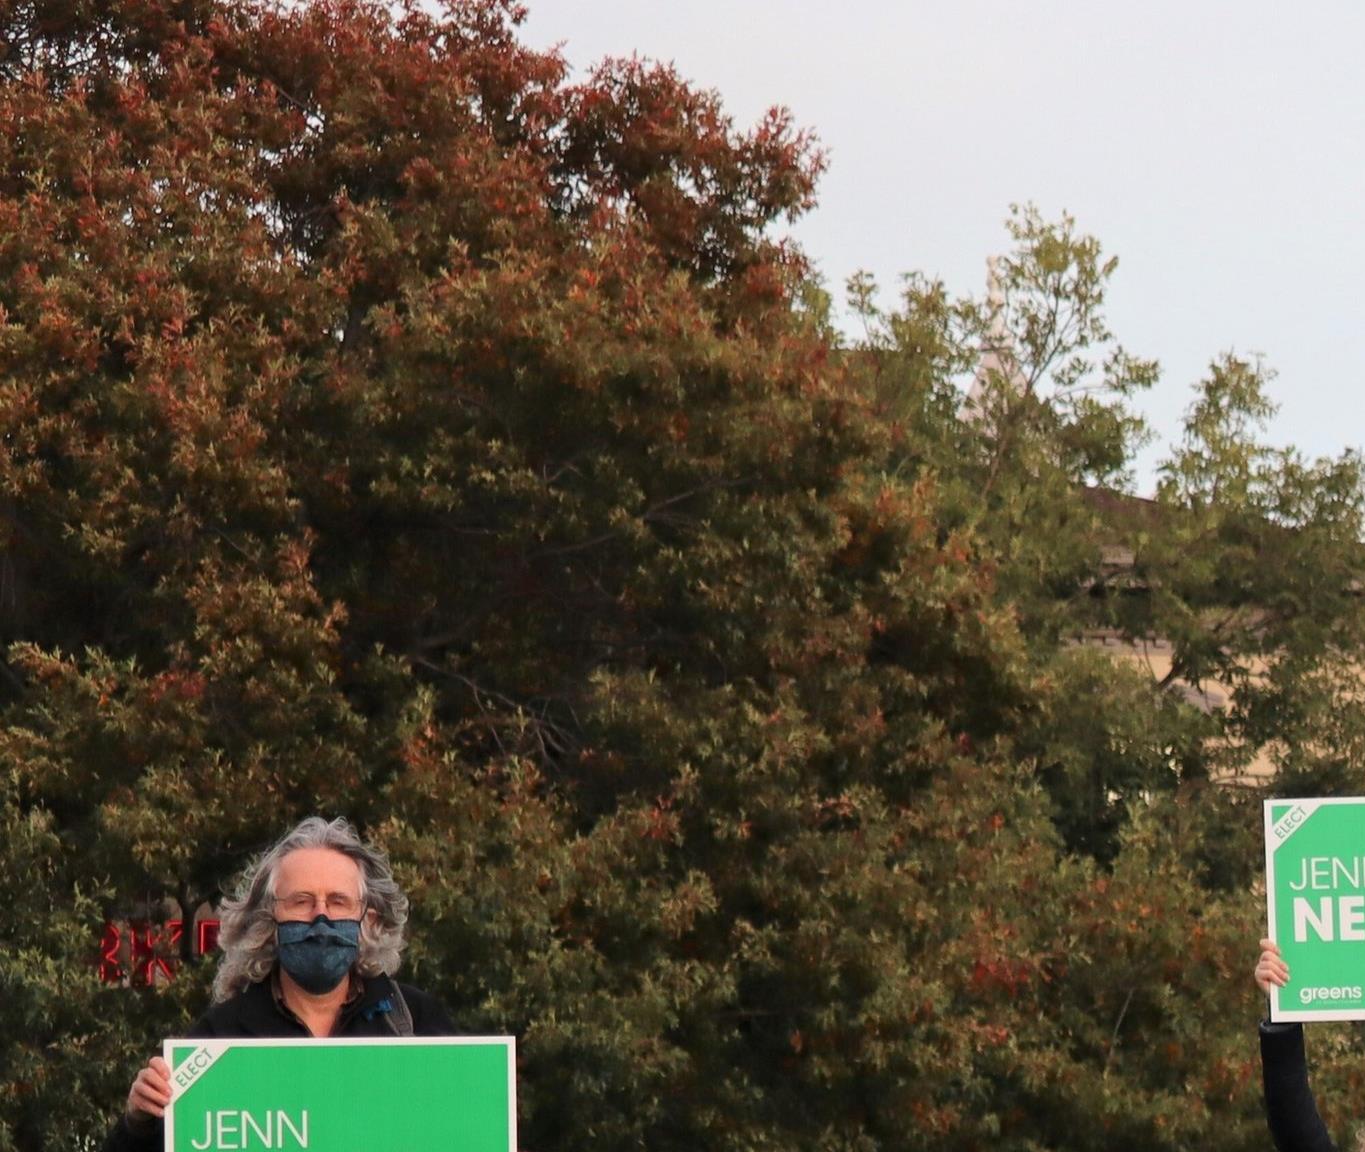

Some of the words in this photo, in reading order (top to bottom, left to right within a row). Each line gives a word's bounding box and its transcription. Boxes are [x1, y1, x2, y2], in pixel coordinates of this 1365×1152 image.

[1274, 804, 1308, 840] ELECT
[1300, 985, 1362, 1004] greens
[174, 1047, 213, 1088] ELECT
[192, 1110, 308, 1150] JENN
